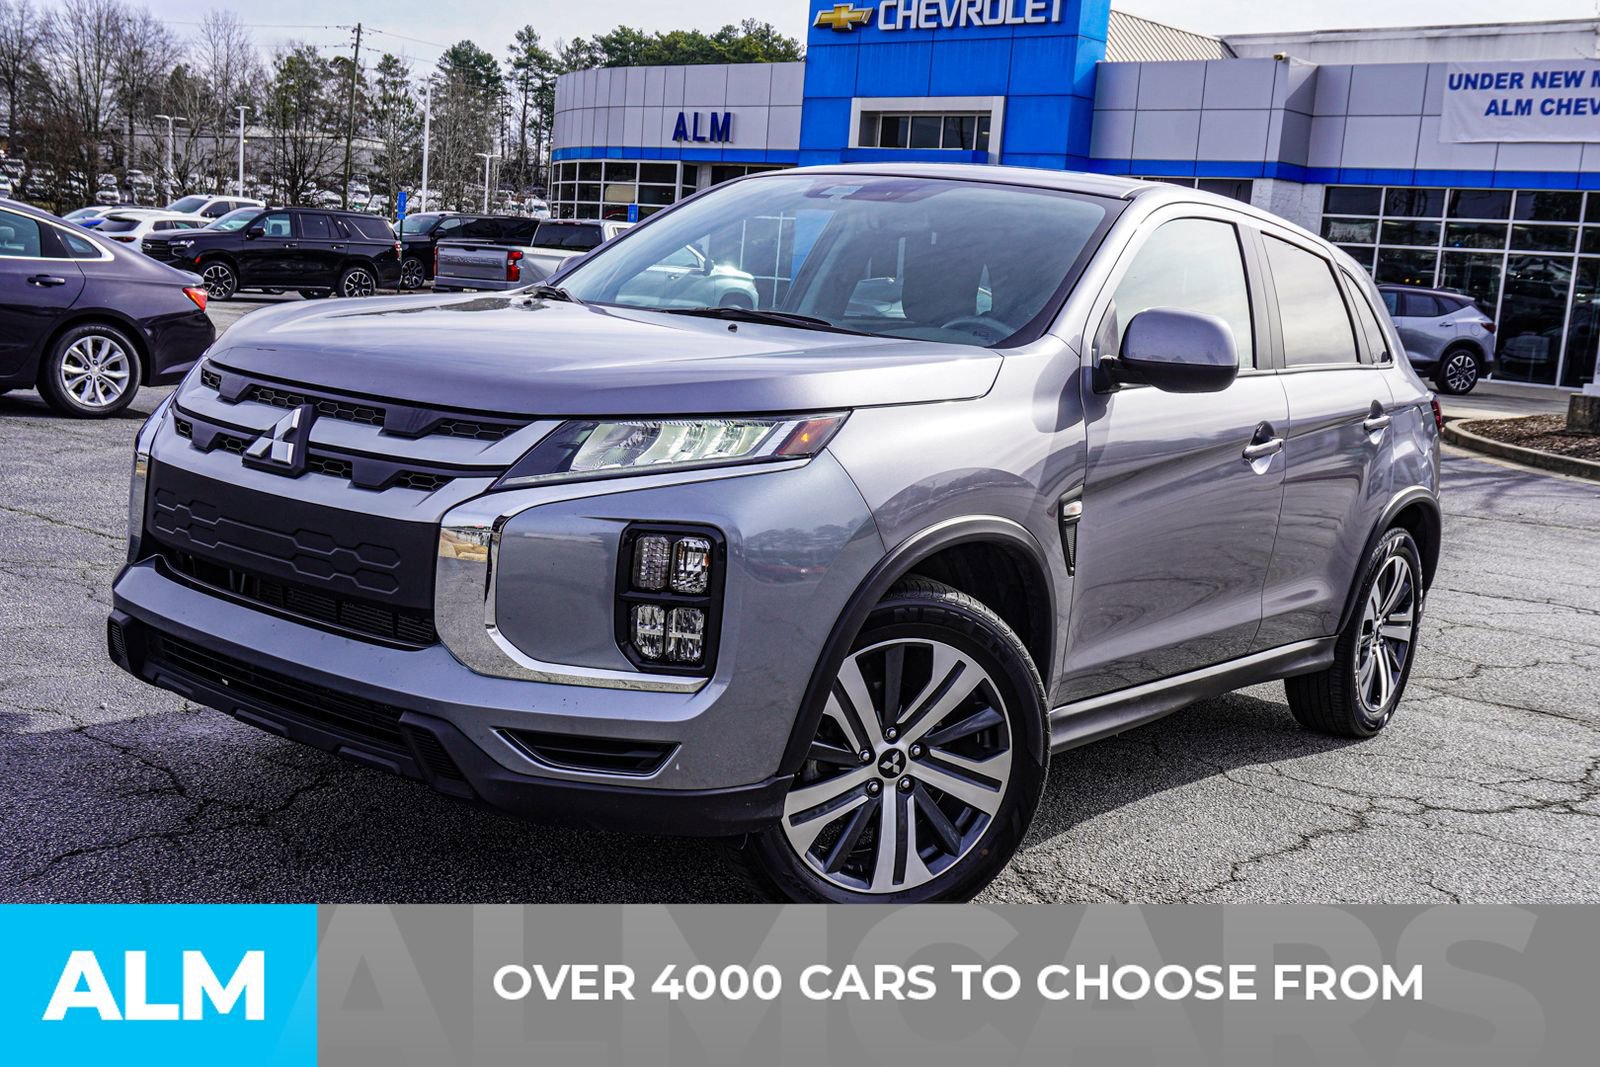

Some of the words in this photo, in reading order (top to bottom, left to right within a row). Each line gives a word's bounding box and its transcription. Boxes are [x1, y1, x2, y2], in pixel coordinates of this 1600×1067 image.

[877, 0, 1062, 31] CHEVROLET
[1448, 72, 1525, 91] UNDER
[1531, 70, 1585, 89] NEW
[1484, 99, 1533, 116] ALM
[671, 106, 733, 144] ALM
